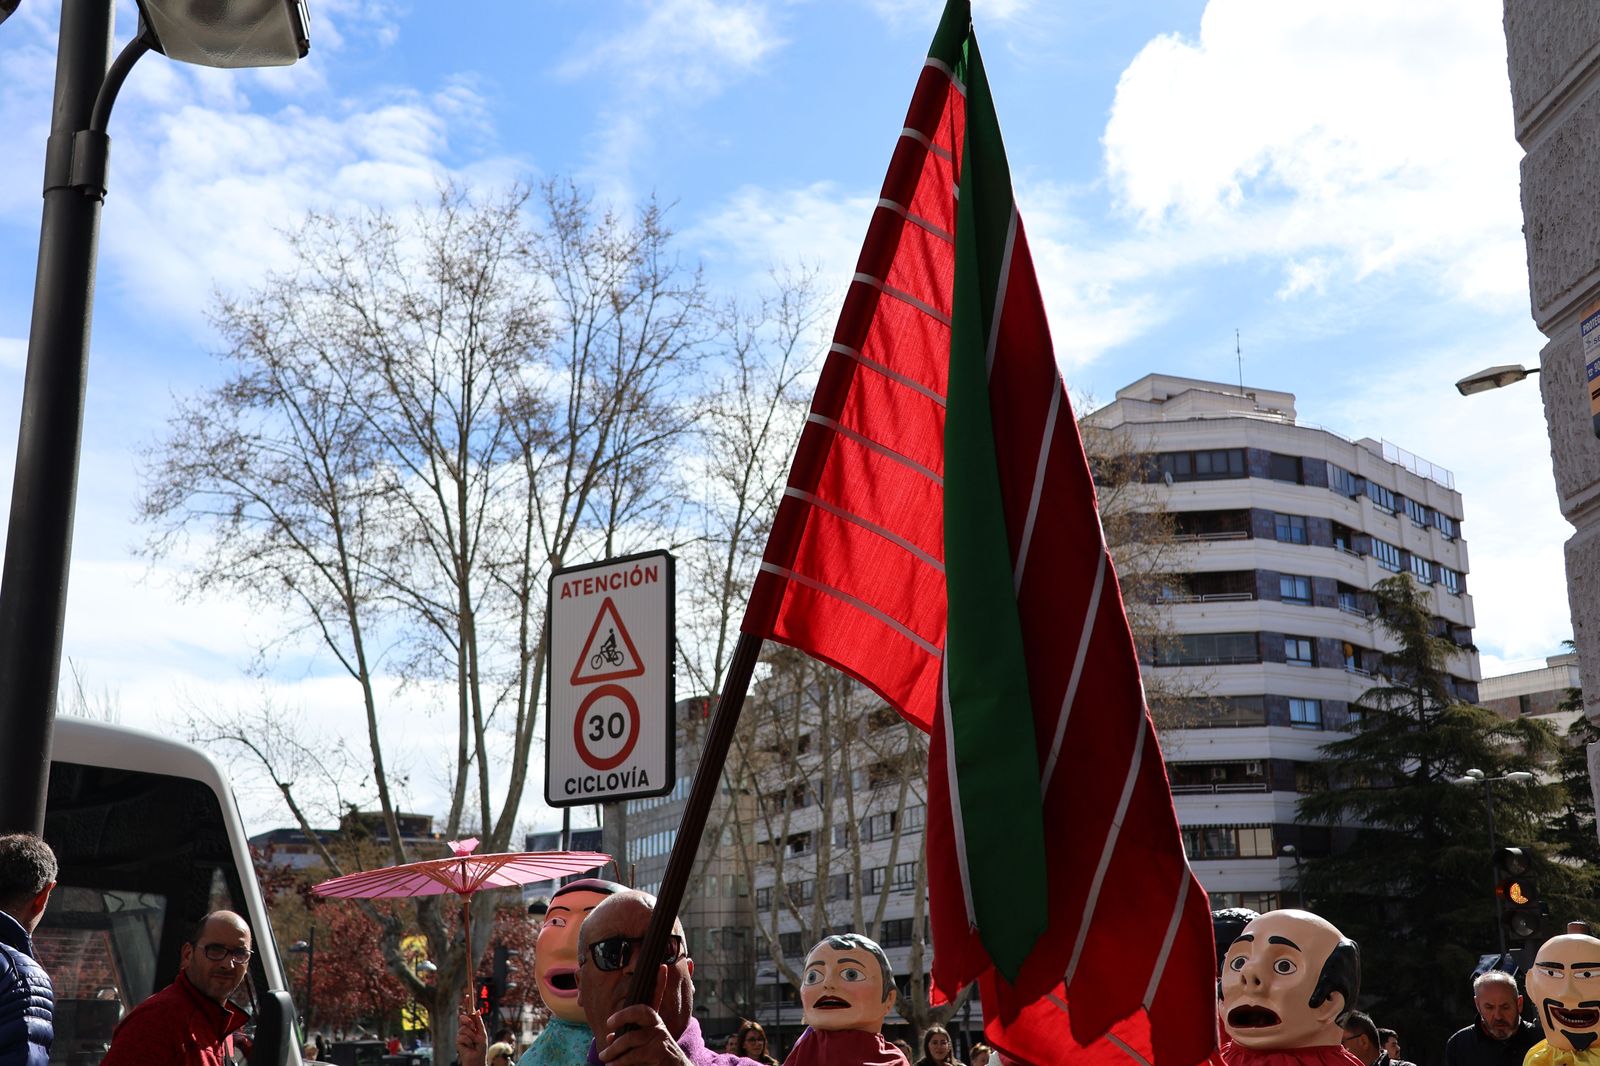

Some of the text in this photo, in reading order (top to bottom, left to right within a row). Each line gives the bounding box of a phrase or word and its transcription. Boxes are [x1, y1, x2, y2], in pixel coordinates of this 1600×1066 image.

[560, 564, 658, 600] ATENCIÓN
[588, 712, 625, 742] 30
[565, 766, 649, 795] CICLOVÍA
